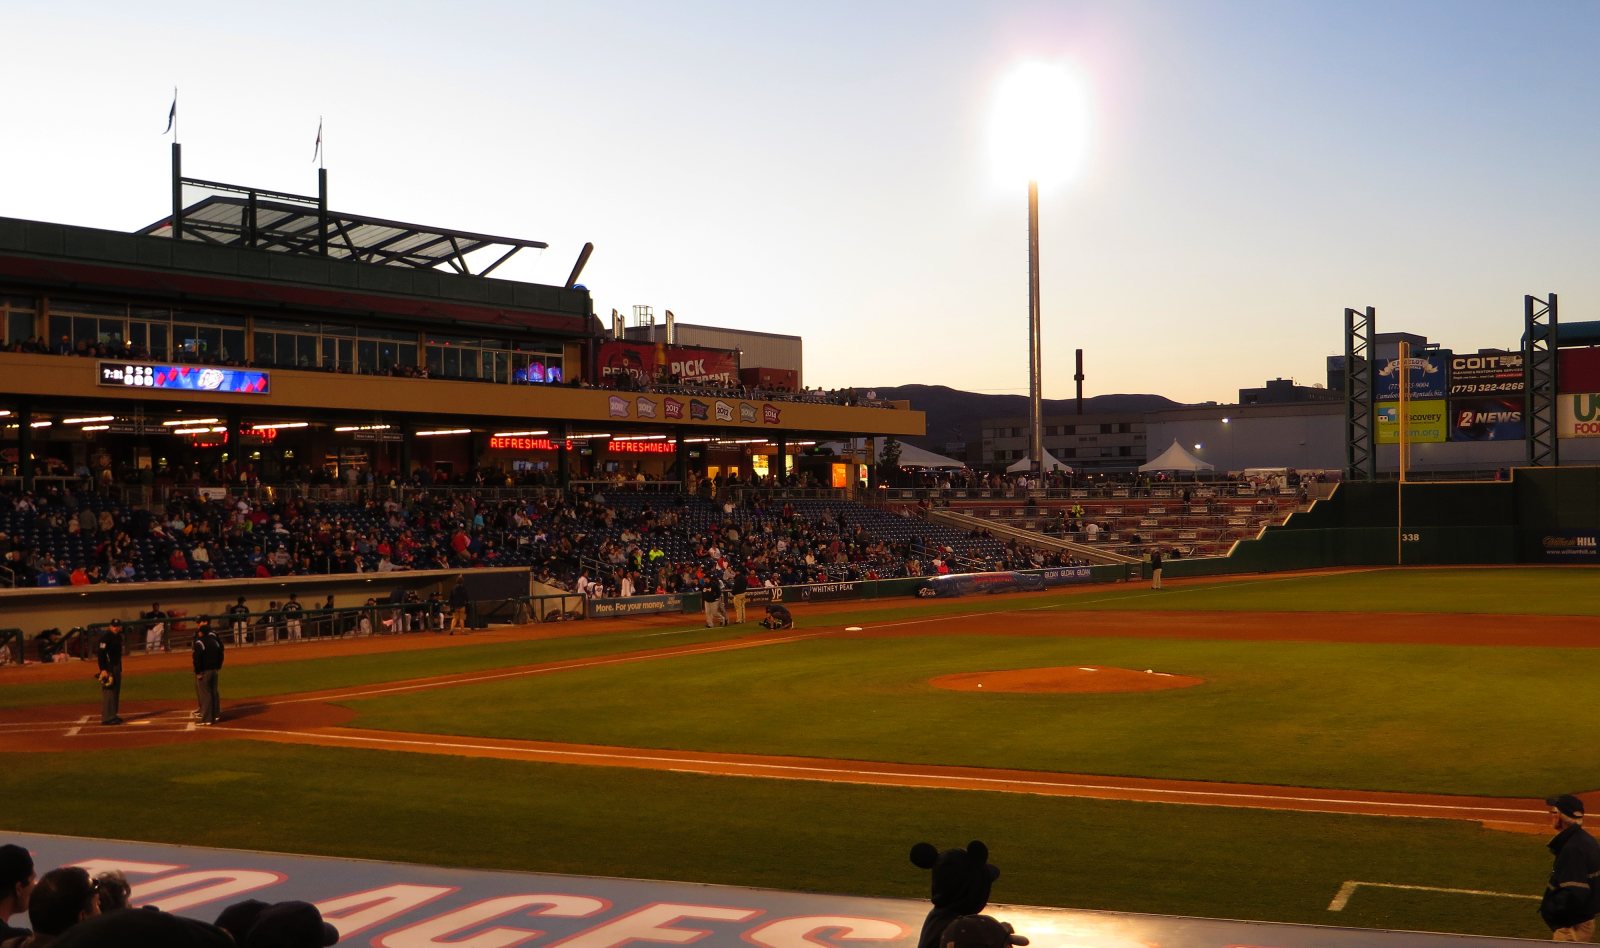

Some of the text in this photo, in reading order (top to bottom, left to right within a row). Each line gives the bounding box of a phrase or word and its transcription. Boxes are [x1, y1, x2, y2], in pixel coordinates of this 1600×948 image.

[671, 359, 706, 376] PICK
[1452, 356, 1499, 370] COIT
[1451, 382, 1524, 394] (775) 322-4266
[665, 404, 679, 413] 2012
[1460, 411, 1522, 427] 2 NEWS
[608, 441, 678, 453] REFRESHMENT
[1401, 533, 1420, 541] 338
[1577, 536, 1597, 547] HILL
[811, 585, 838, 593] WHITNEY
[595, 604, 614, 612] More.
[615, 602, 627, 611] For
[627, 603, 641, 611] your
[642, 601, 665, 609] money.
